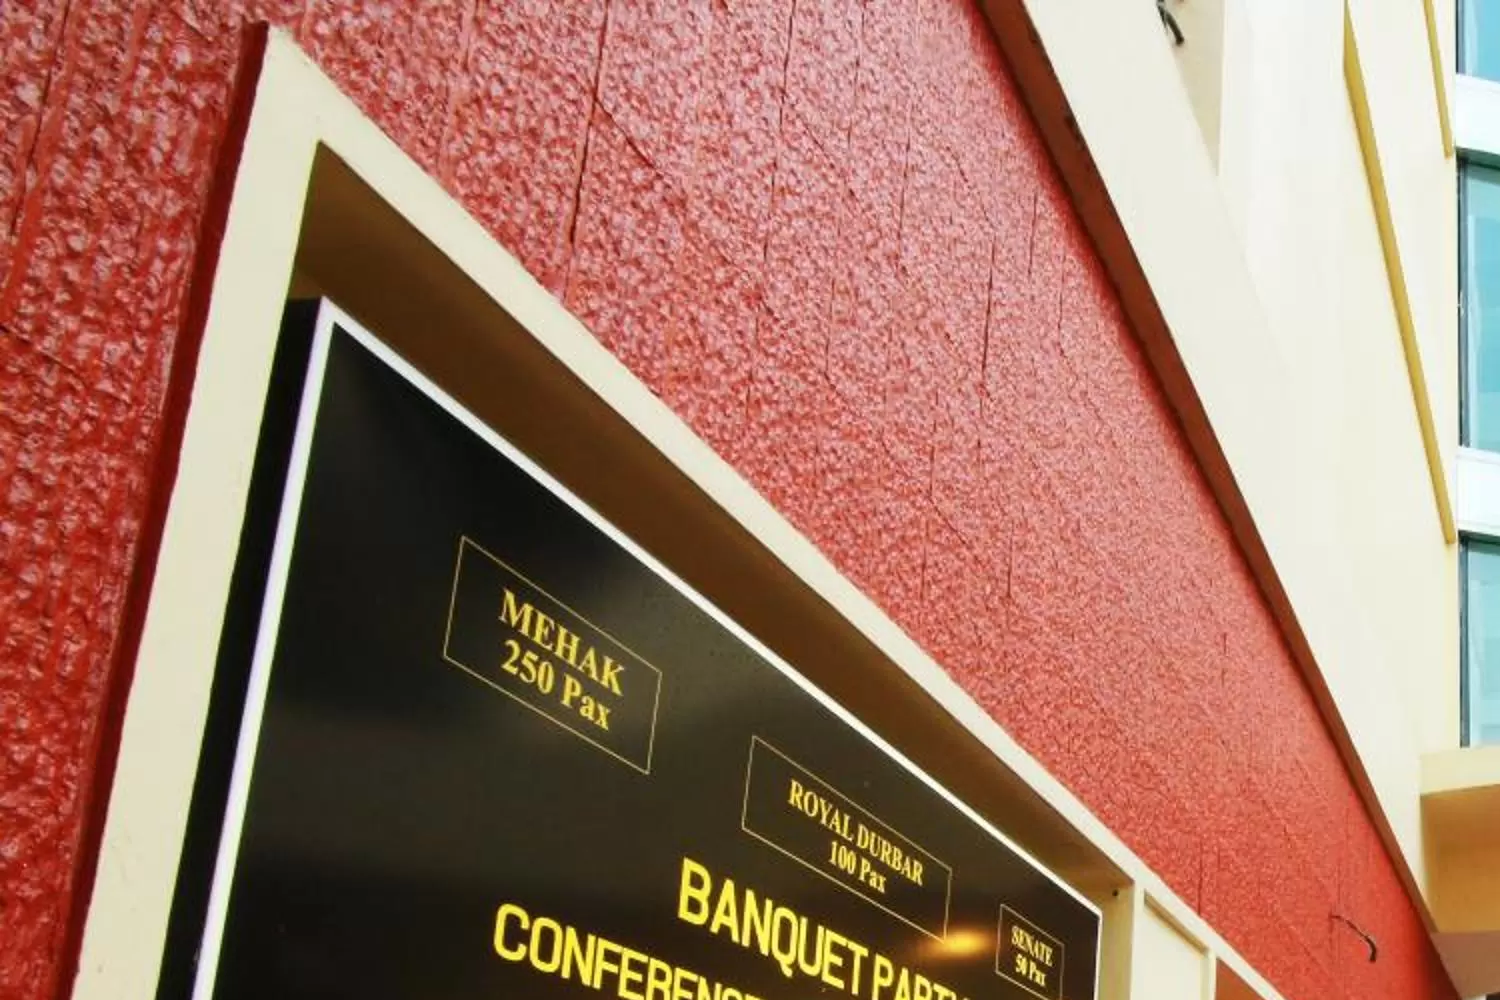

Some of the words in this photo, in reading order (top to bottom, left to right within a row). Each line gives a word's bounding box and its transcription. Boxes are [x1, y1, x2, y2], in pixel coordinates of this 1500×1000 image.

[499, 587, 625, 697] MEHAK
[501, 639, 555, 695] 250
[560, 672, 611, 731] Pax
[788, 779, 854, 842] ROYAL
[856, 823, 923, 886] DURBAR
[829, 841, 857, 874] 100
[858, 857, 886, 893] Pax
[677, 856, 869, 996] BANQUET
[1011, 925, 1053, 967] SENATE
